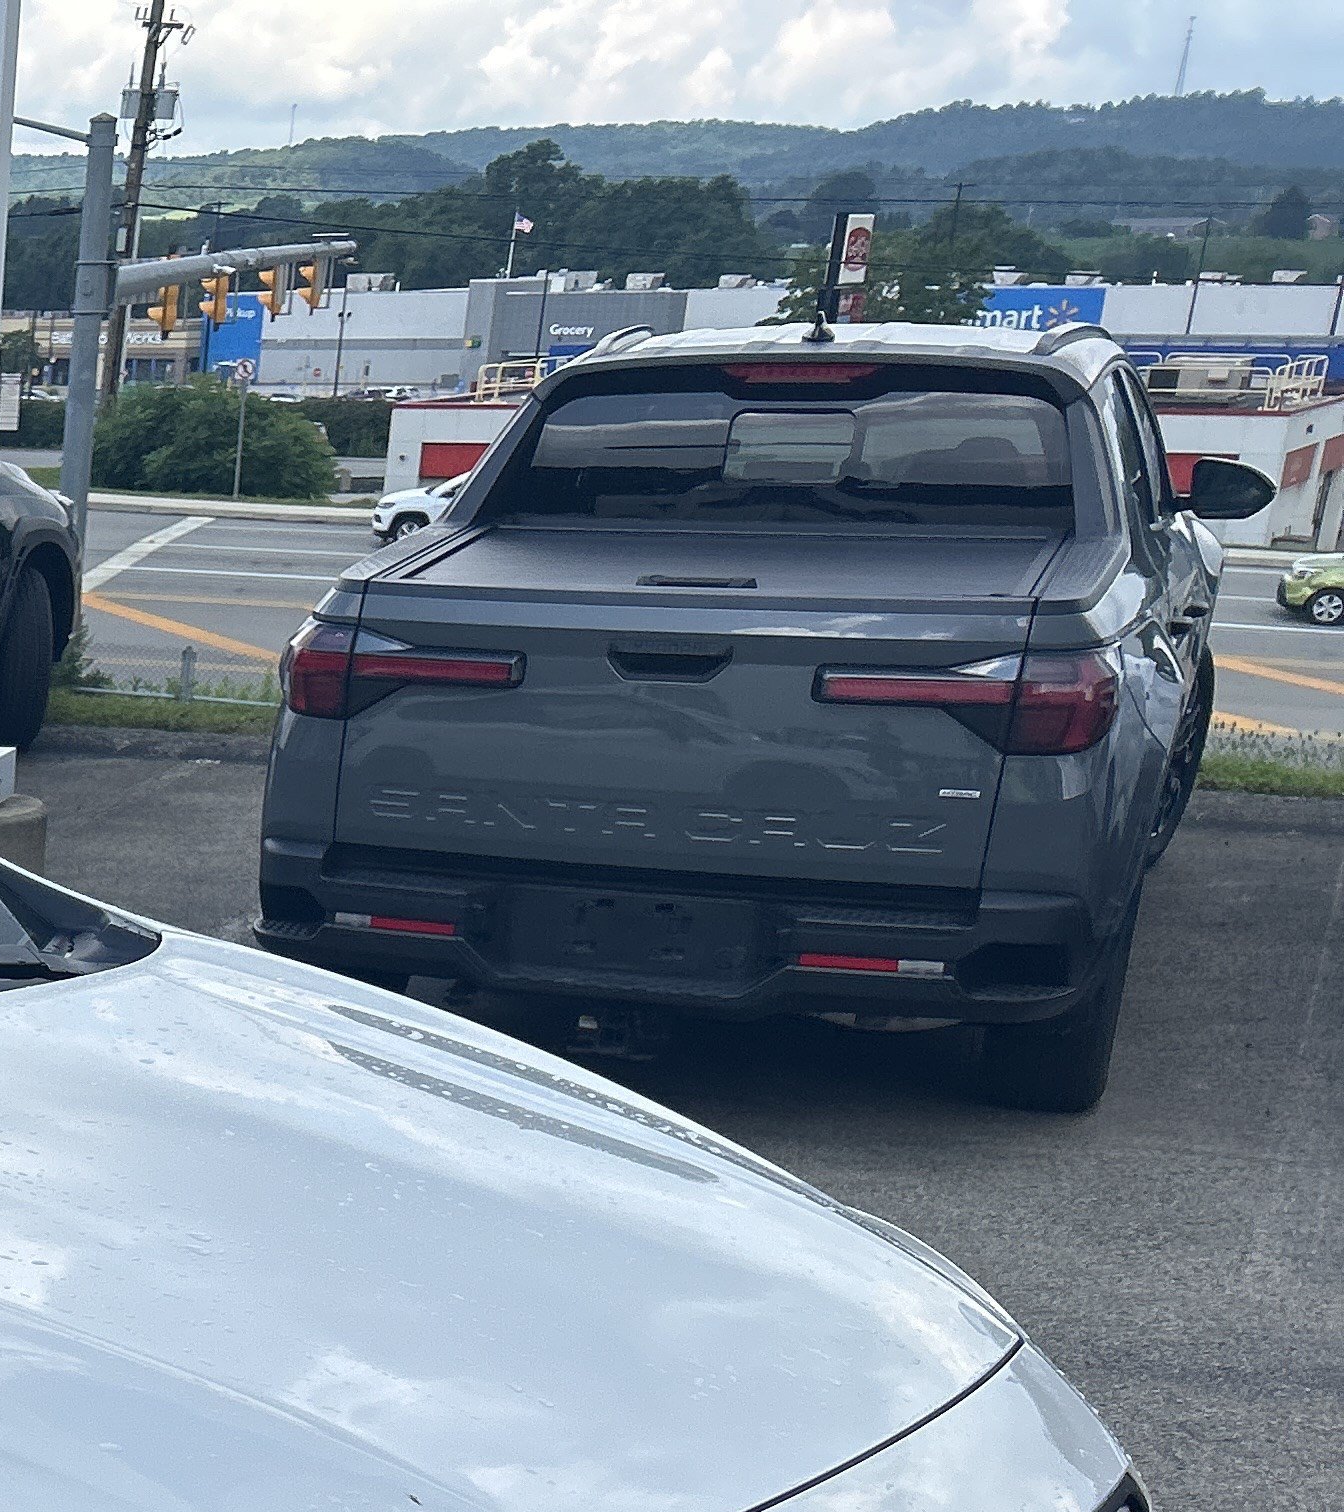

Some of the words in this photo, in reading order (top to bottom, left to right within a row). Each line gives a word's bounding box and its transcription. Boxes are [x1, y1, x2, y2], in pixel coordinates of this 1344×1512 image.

[960, 304, 1044, 330] mart
[549, 323, 595, 338] Grocery
[370, 788, 656, 839] SANTA
[683, 811, 948, 854] CRUZ
